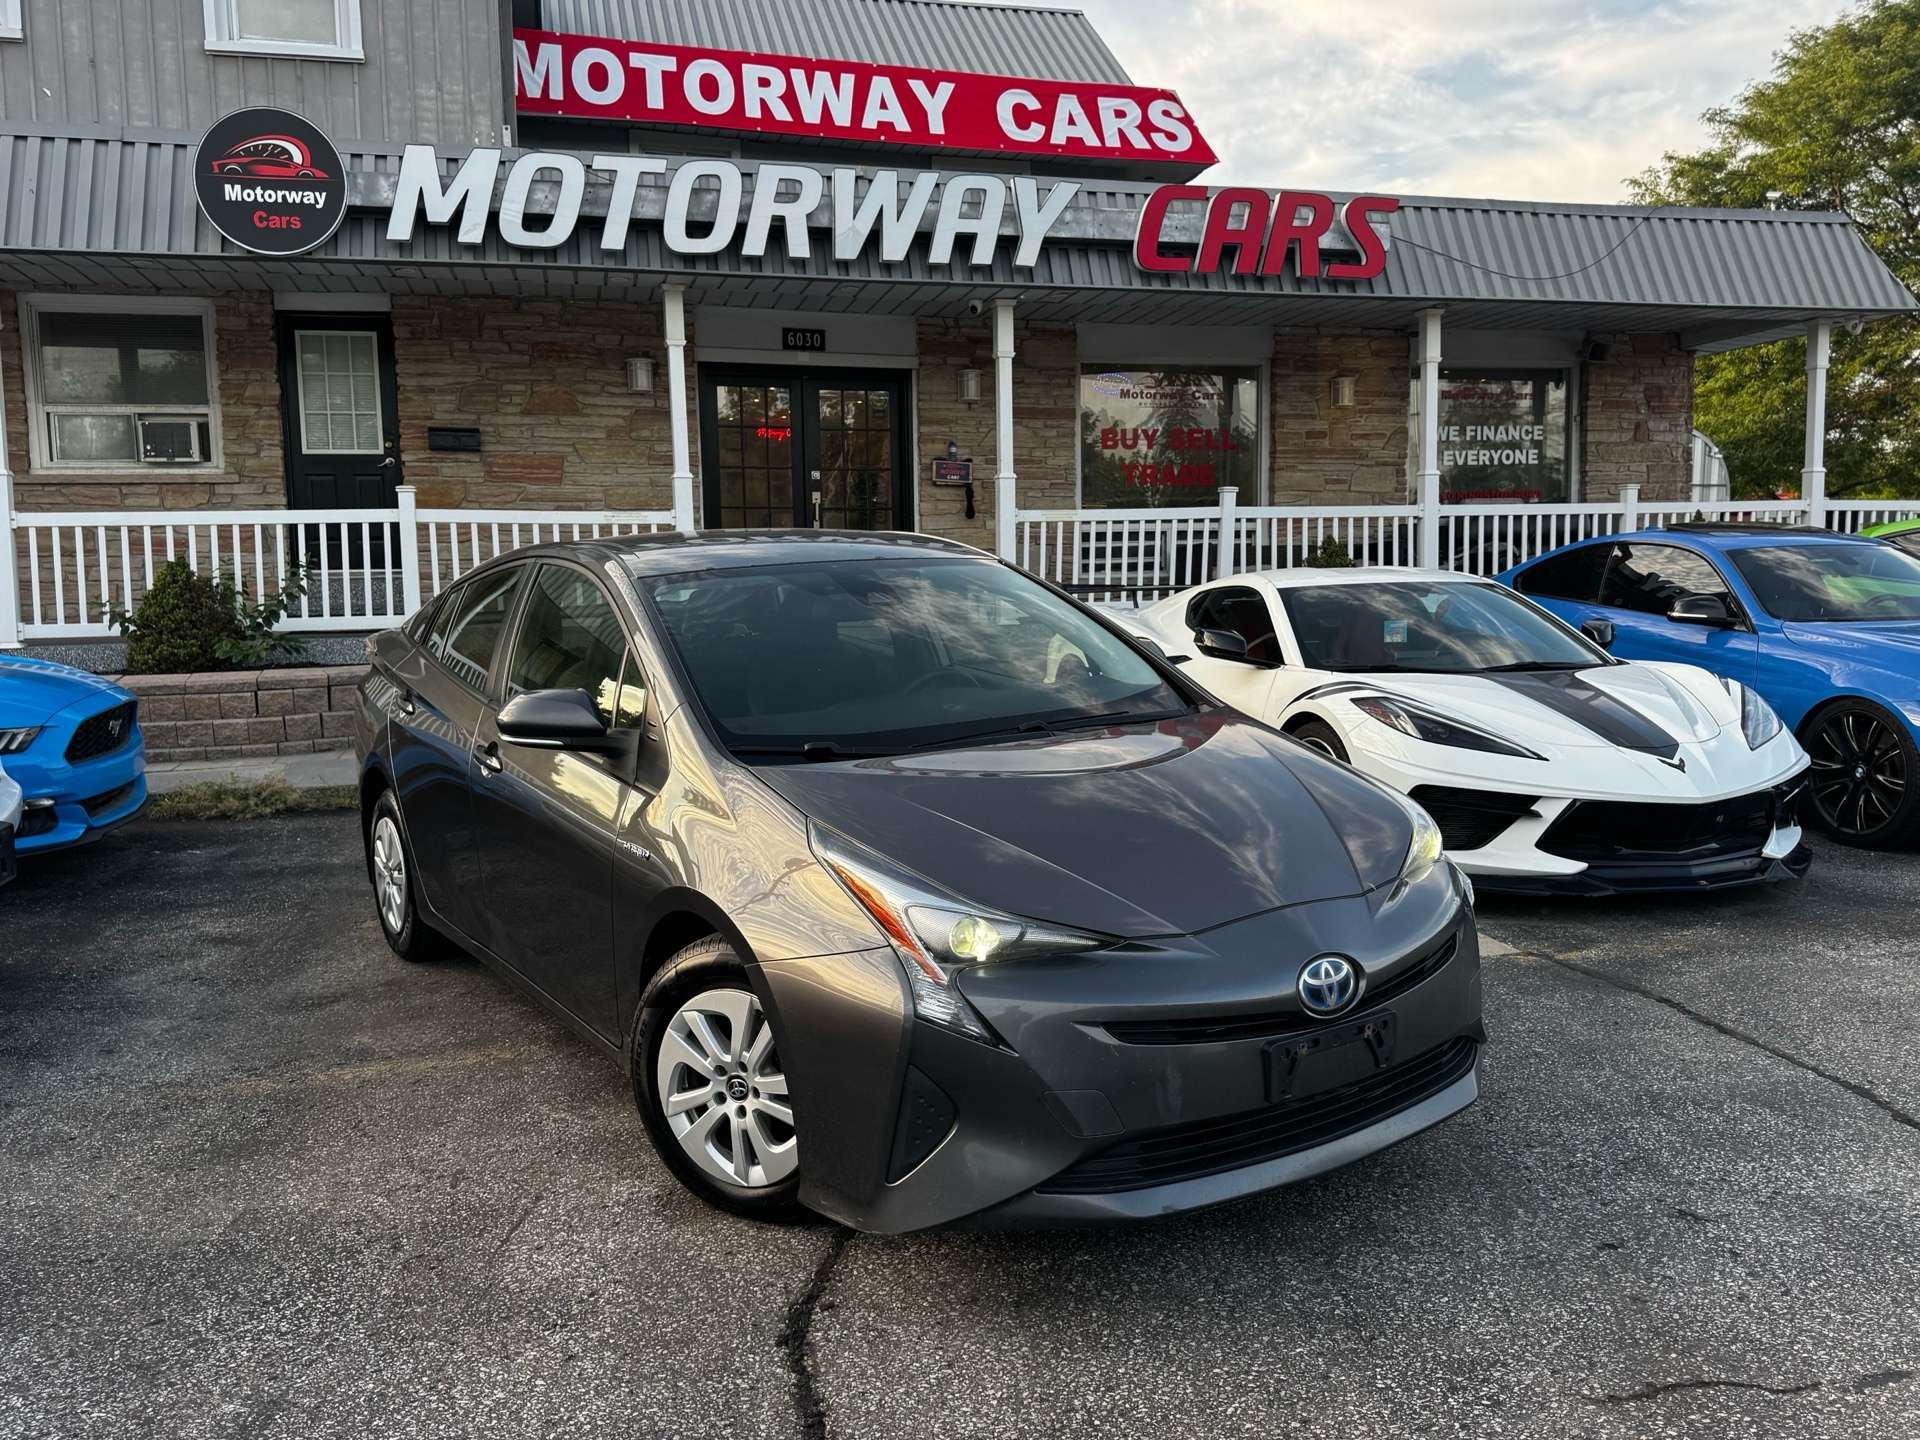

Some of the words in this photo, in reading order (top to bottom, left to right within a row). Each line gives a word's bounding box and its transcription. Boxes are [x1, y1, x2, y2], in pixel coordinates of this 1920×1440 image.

[513, 39, 955, 136] MOTORWAY
[996, 89, 1193, 152] CARS
[224, 183, 327, 208] Motorway
[253, 210, 302, 229] Cars
[386, 144, 1082, 268] MOTORWAY
[1134, 185, 1400, 279] CARS
[787, 332, 821, 347] 6030
[1101, 427, 1159, 450] BUY
[1167, 427, 1237, 450] SELL
[1465, 425, 1544, 441] FINANCE
[1443, 449, 1539, 465] EVERYONE
[1122, 463, 1216, 486] TRADE
